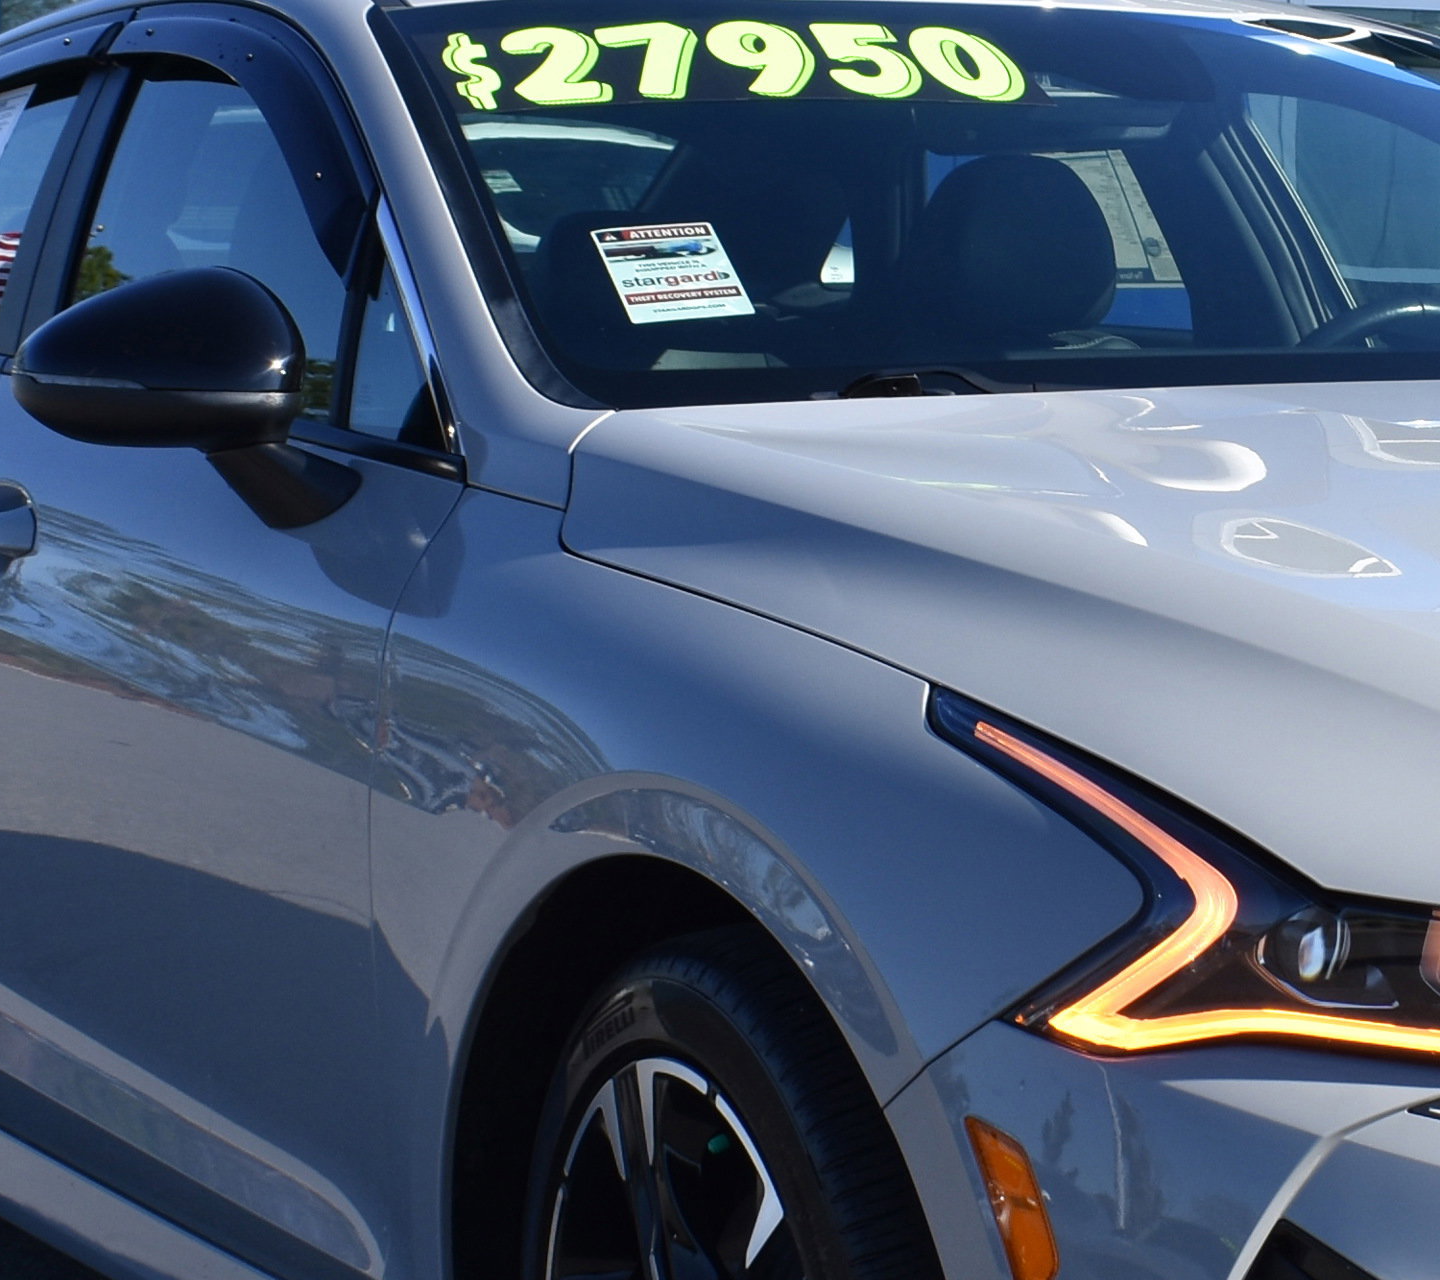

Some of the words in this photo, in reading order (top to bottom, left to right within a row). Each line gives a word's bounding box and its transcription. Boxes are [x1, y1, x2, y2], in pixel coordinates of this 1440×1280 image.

[441, 20, 1026, 111] $27950
[629, 226, 707, 240] ATTENTION
[622, 270, 717, 288] stargard
[629, 294, 656, 303] THEFT
[658, 290, 702, 301] RECOVERY
[704, 287, 738, 297] SYSTEM
